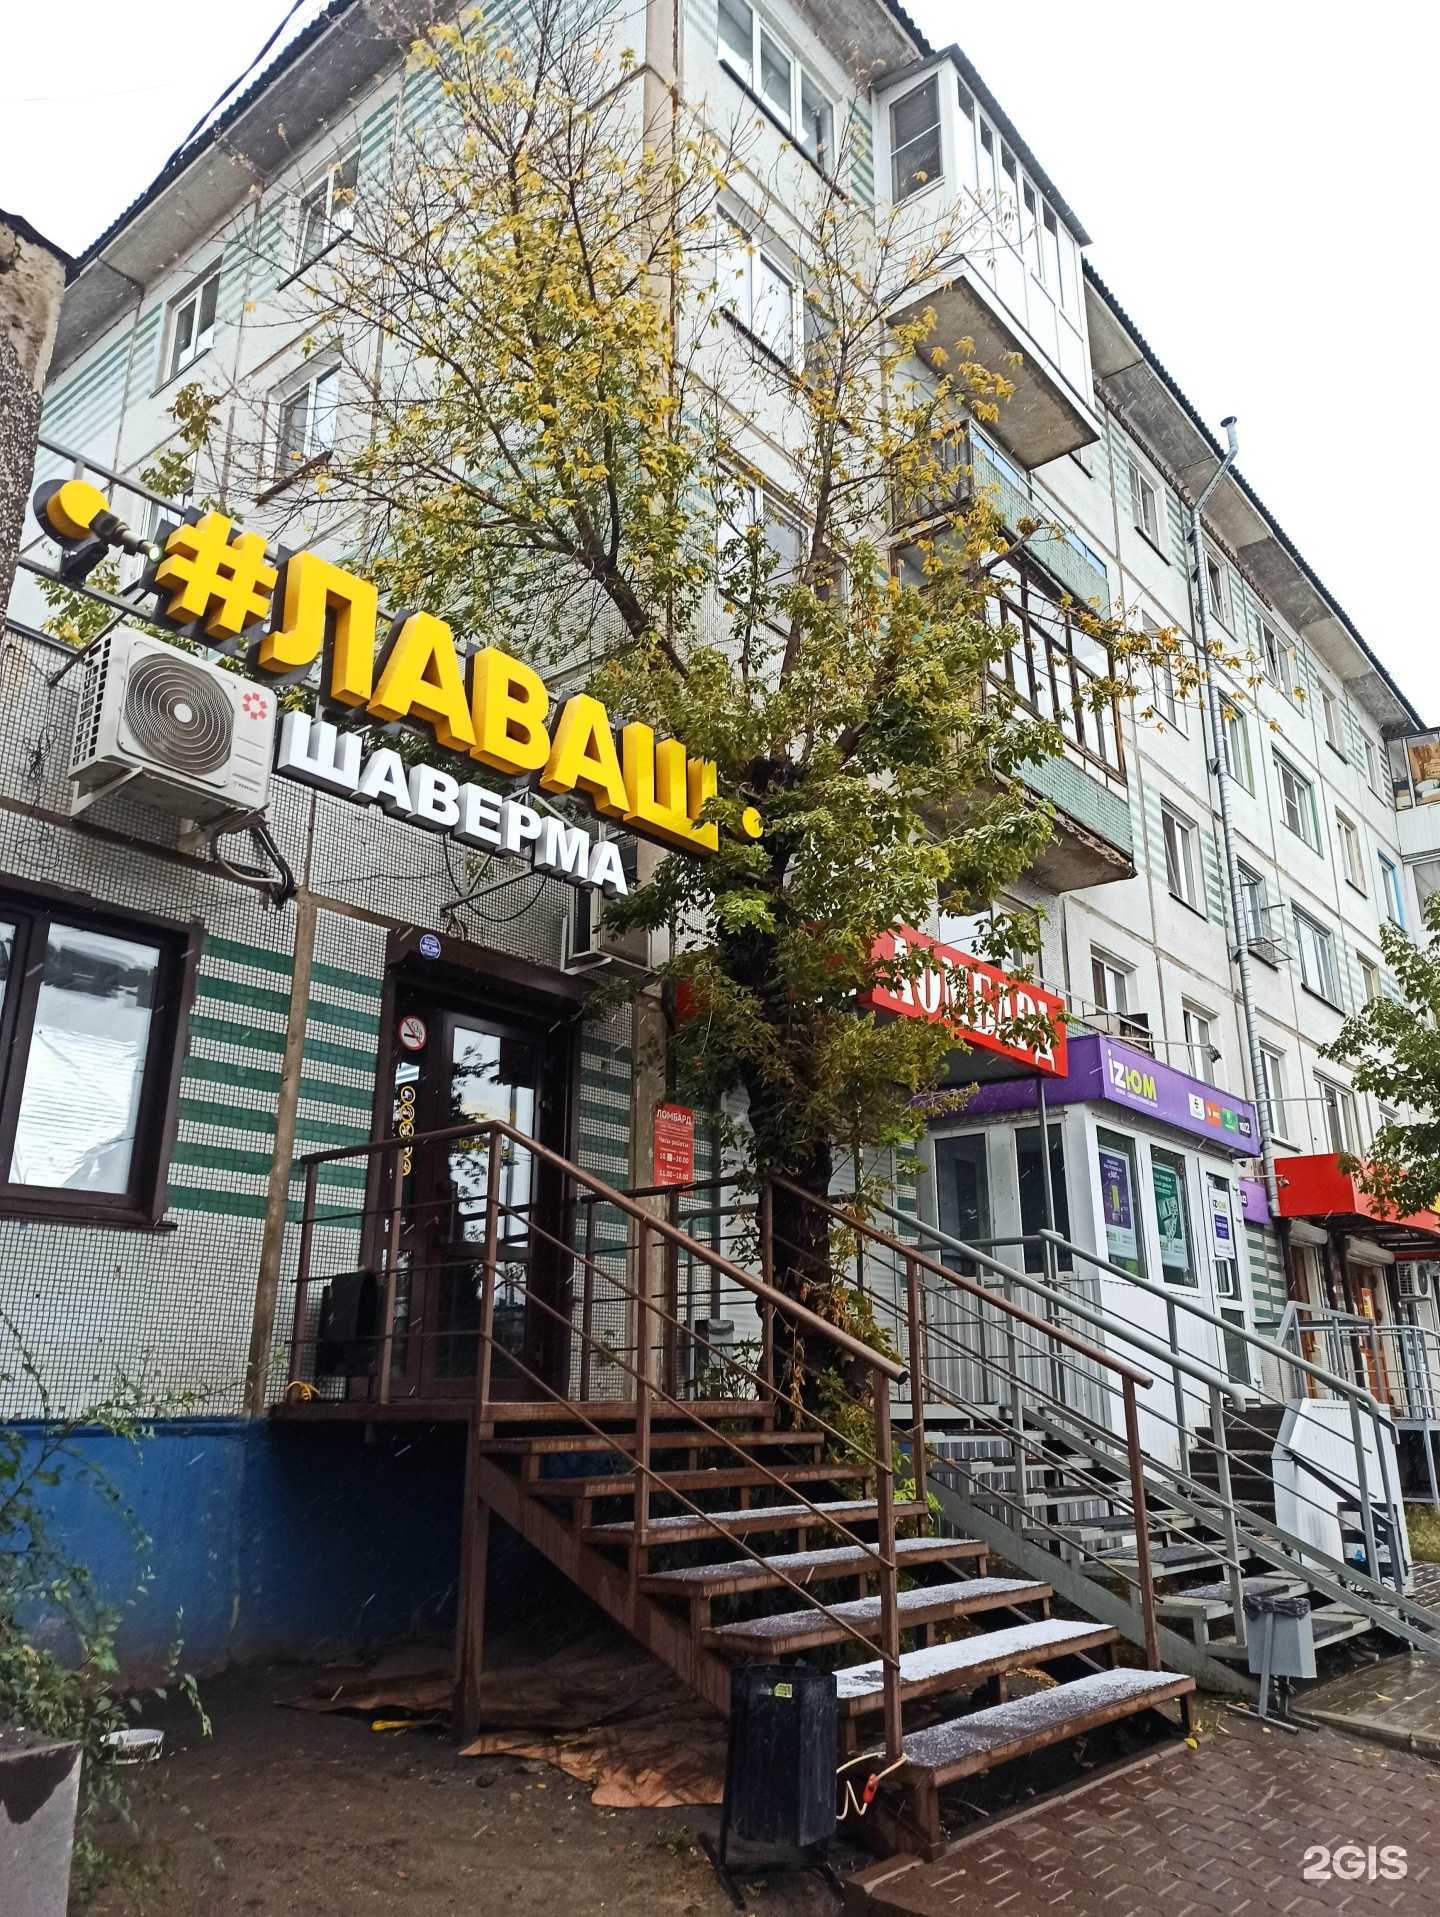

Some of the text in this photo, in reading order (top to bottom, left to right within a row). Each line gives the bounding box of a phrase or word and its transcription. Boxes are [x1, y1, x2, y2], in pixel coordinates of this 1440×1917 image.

[155, 510, 720, 853] #ЛАВАШ
[276, 710, 629, 897] ШАВЕРМА
[656, 1109, 693, 1126] ЛОМБАРД
